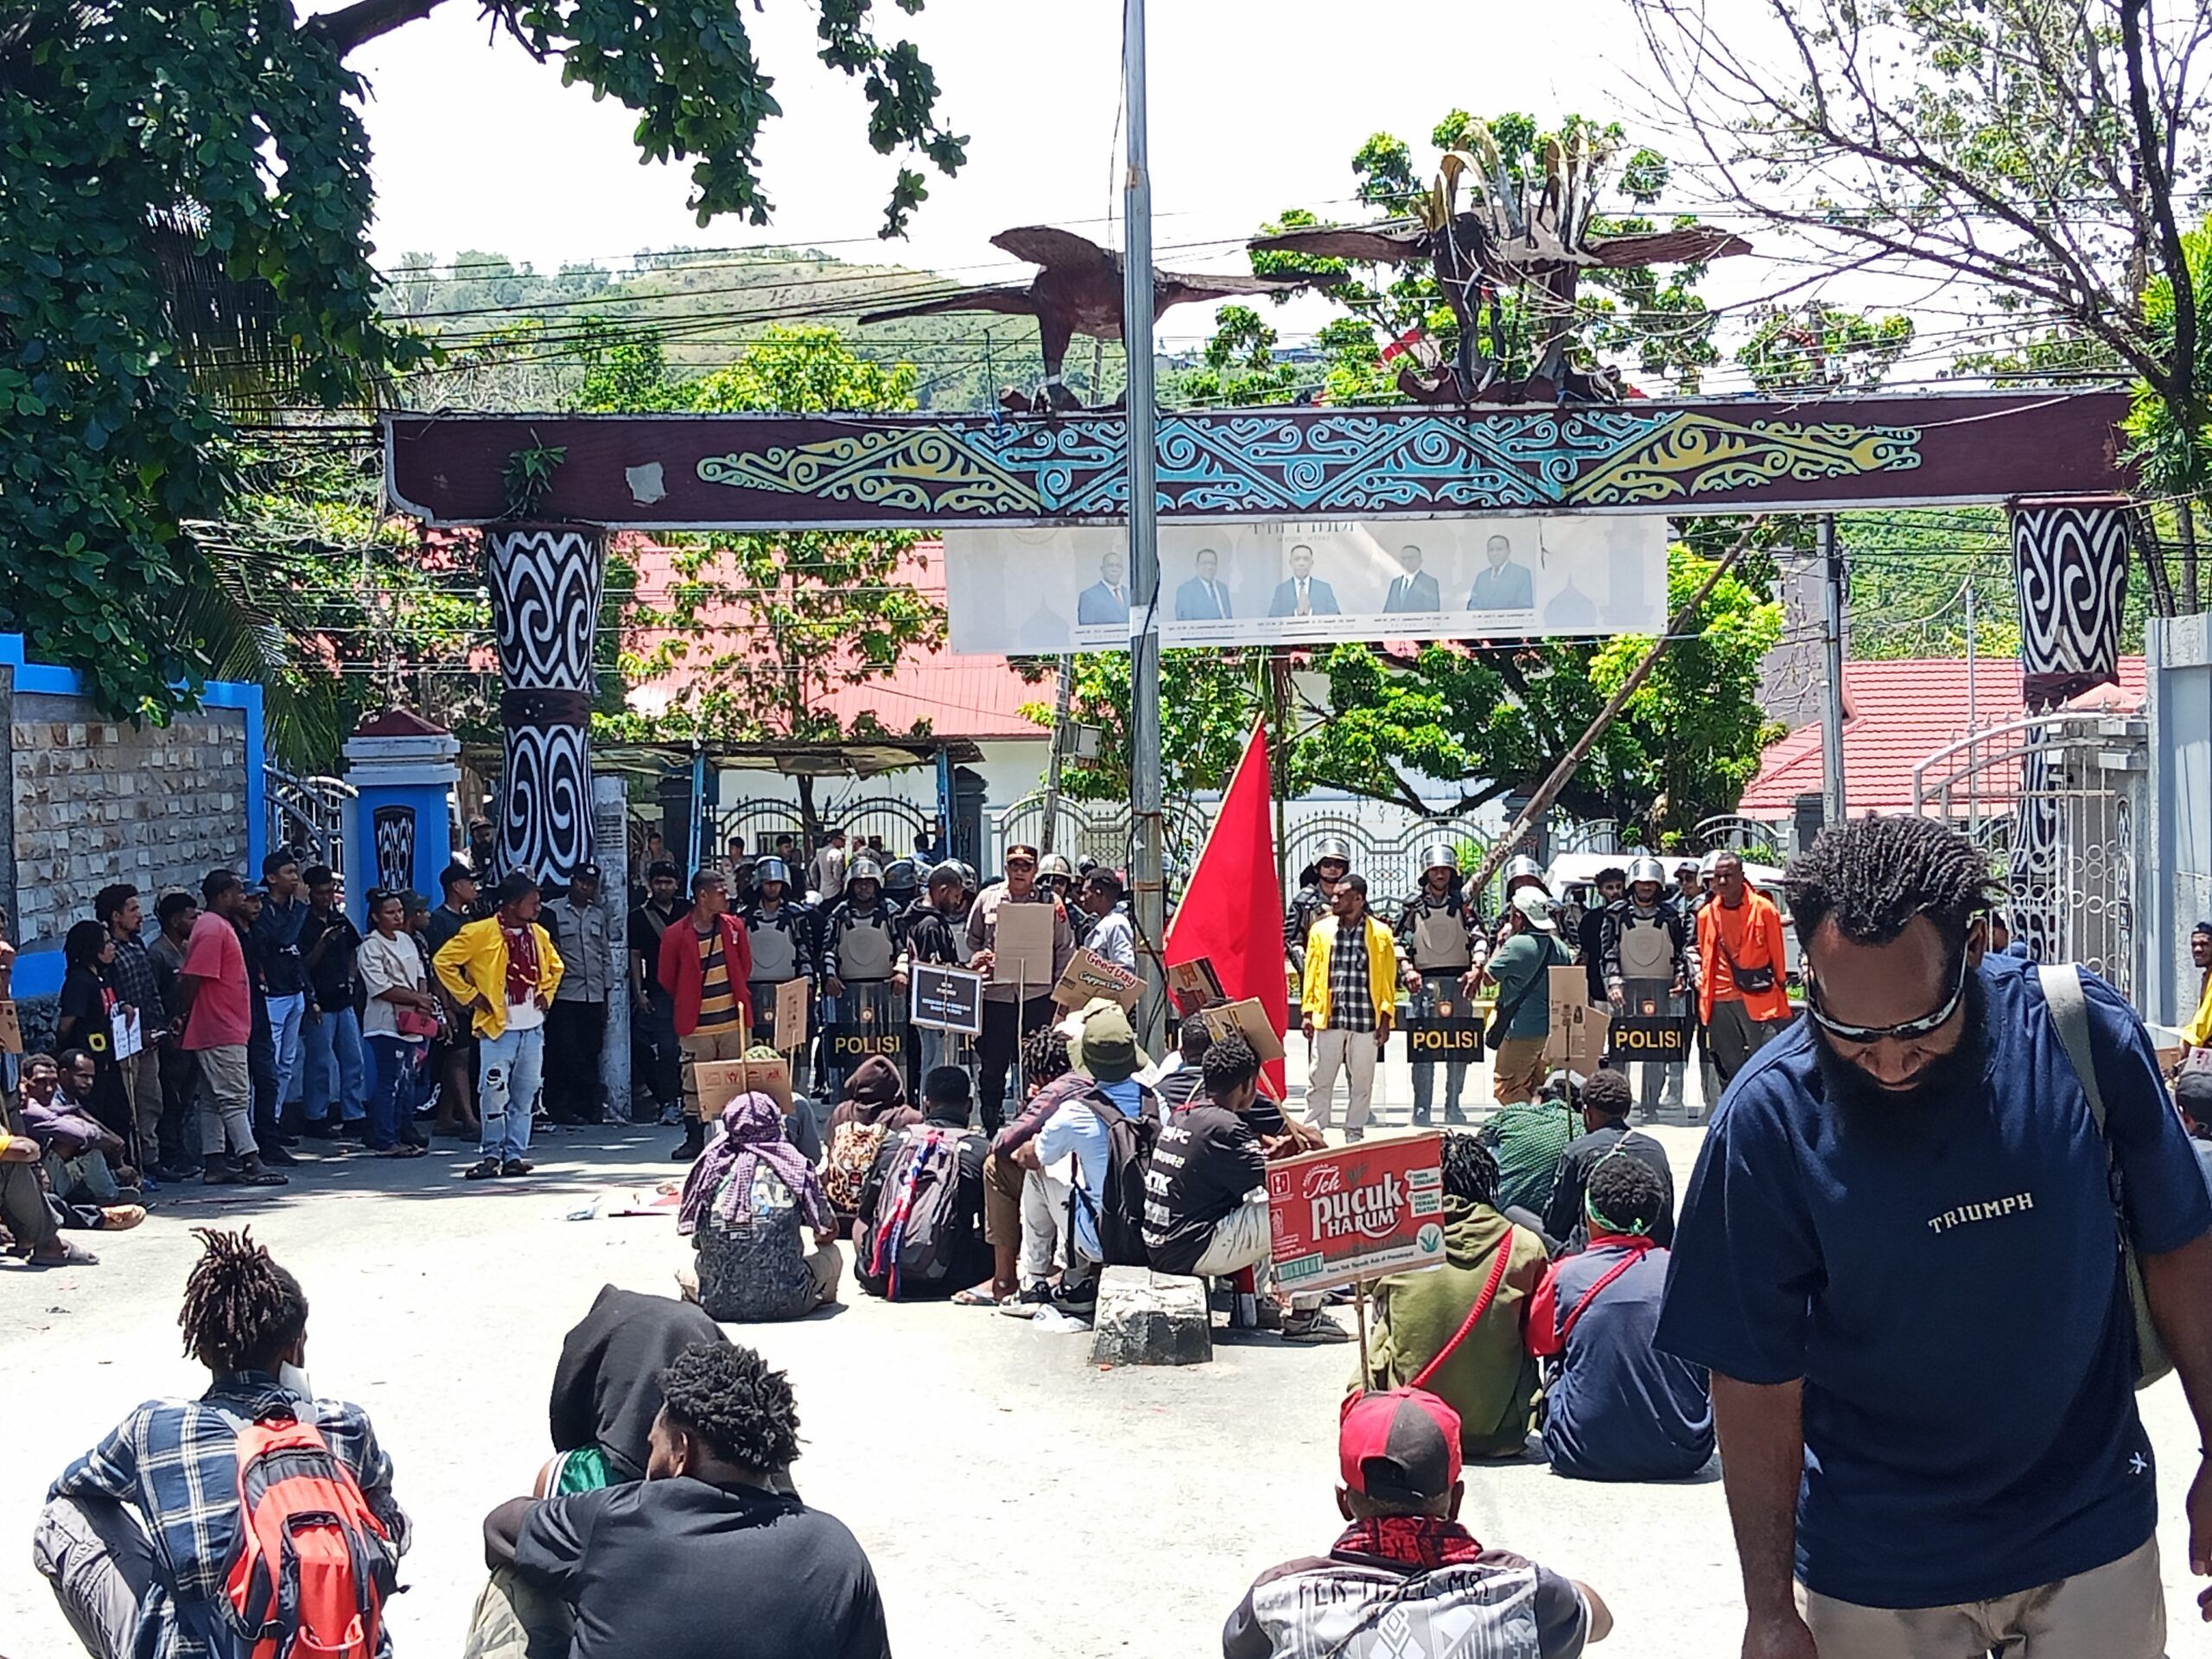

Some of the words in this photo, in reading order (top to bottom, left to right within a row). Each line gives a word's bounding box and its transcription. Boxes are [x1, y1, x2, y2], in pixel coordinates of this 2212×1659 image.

[835, 1036, 901, 1054] POLISI
[1413, 1031, 1478, 1049] POLISI
[1616, 1031, 1681, 1049] POLISI
[1303, 1166, 1341, 1198] Teh
[1312, 1173, 1405, 1242] pucuk
[1928, 1192, 2034, 1234] TRIUMPH
[1328, 1212, 1395, 1237] HARUM
